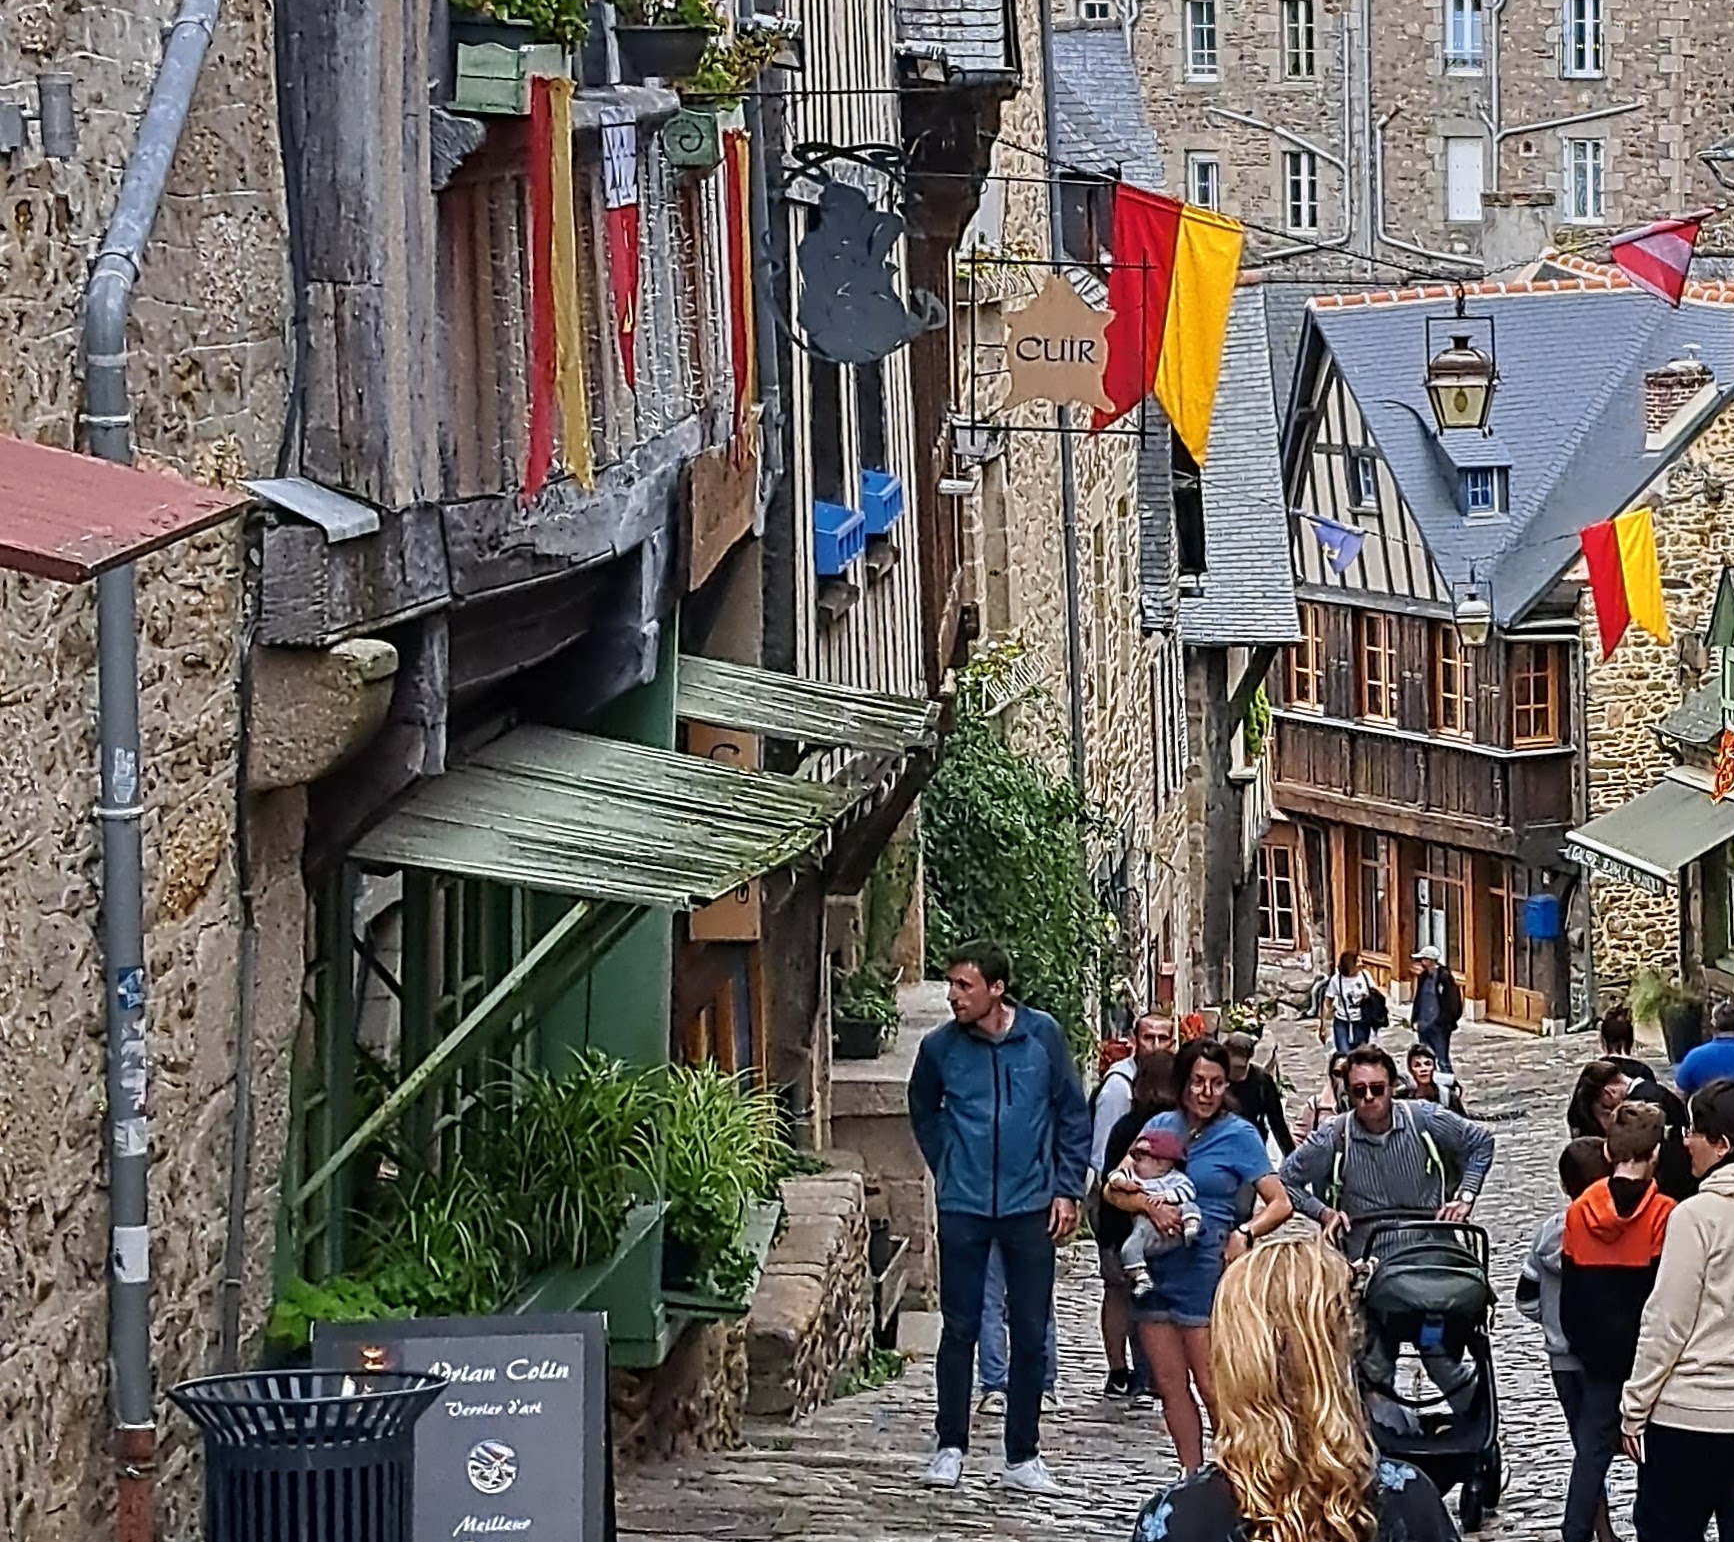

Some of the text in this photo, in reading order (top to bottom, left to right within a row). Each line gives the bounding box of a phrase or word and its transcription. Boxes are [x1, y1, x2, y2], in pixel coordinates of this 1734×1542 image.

[1016, 335, 1097, 364] CUIR
[506, 1358, 569, 1381] Colin
[507, 1398, 542, 1415] d'art
